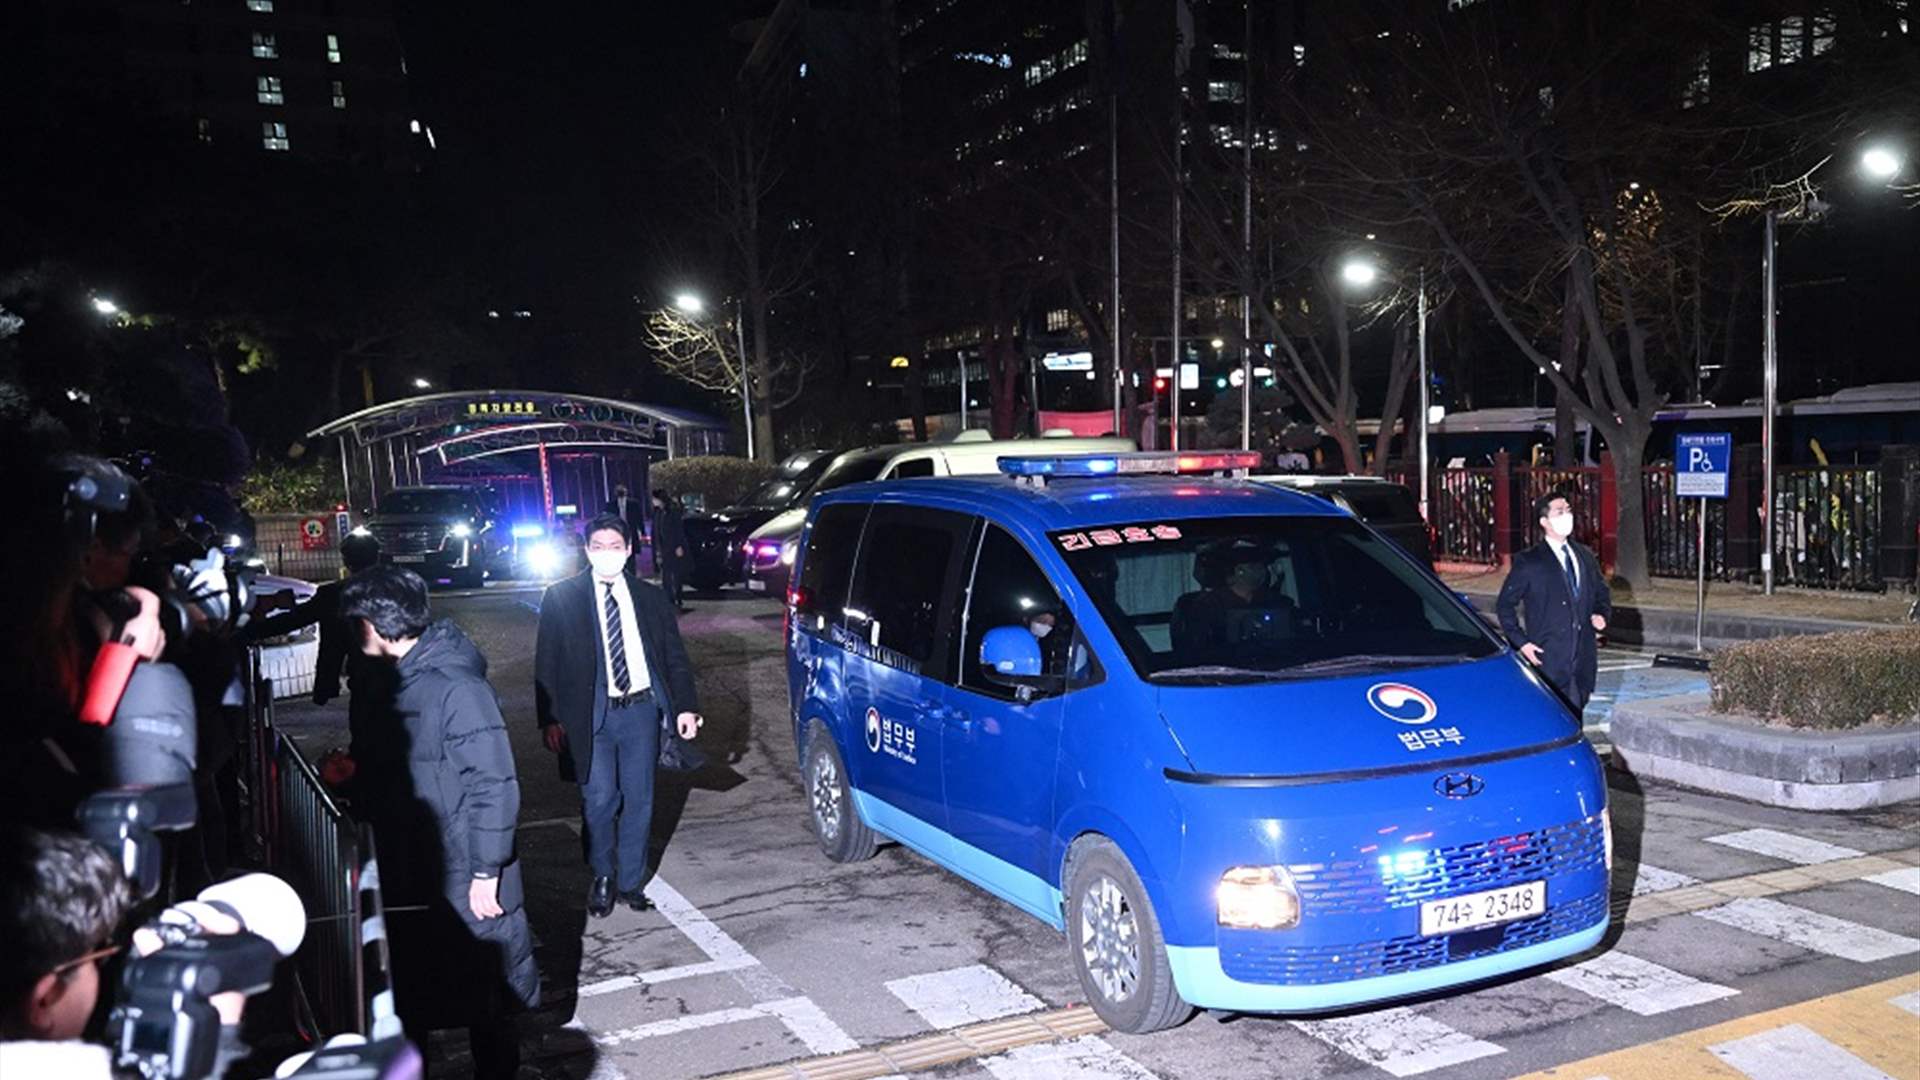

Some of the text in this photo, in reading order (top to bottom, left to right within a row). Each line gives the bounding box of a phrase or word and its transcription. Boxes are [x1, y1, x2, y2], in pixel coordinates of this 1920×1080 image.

[1690, 447, 1703, 472] P
[1058, 524, 1182, 551] 긴급호송
[882, 717, 915, 753] 법무부
[1397, 727, 1466, 751] 법무부
[1434, 888, 1534, 927] 74수 2348
